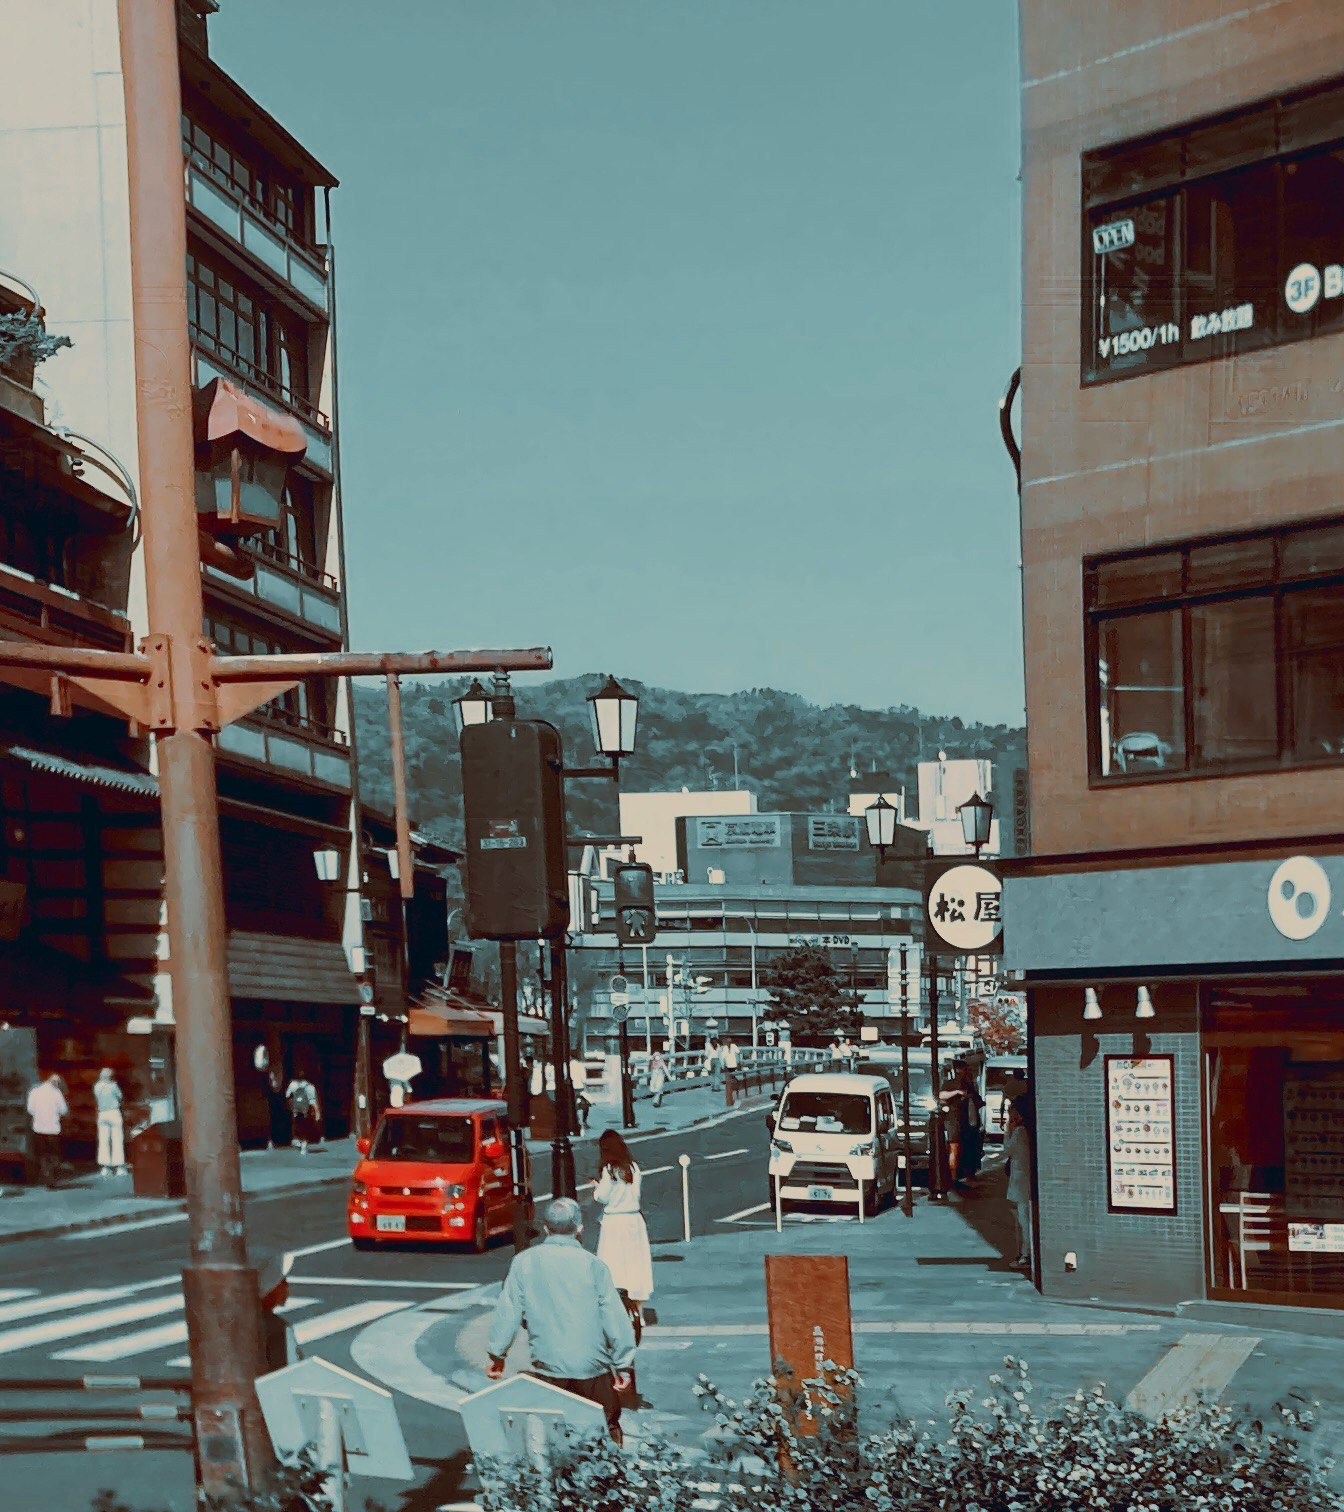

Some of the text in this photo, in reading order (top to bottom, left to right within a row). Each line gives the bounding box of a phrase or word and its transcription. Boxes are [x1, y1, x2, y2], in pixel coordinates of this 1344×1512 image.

[1095, 224, 1134, 249] OPEN
[1290, 275, 1316, 302] 3F
[933, 890, 1003, 923] 松屋
[832, 935, 850, 945] DVD
